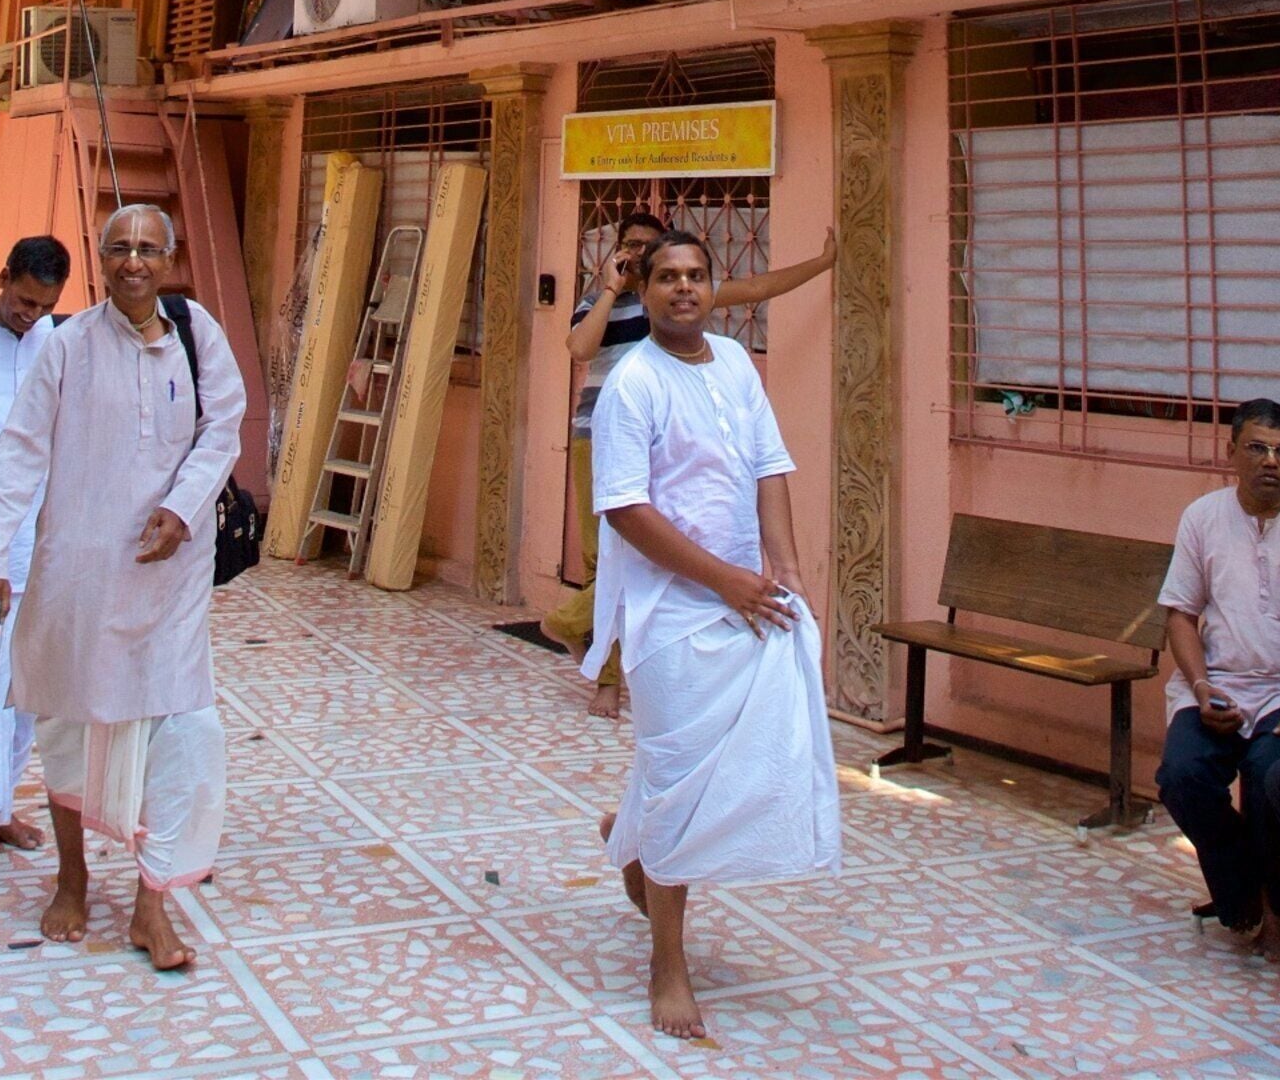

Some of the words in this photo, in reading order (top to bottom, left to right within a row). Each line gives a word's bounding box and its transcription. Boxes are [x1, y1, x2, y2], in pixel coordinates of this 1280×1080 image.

[607, 123, 636, 145] VTA
[642, 118, 720, 143] PREMISES
[596, 155, 616, 168] Entry
[635, 153, 647, 165] for
[649, 151, 689, 165] Authorised
[691, 150, 729, 163] Residents
